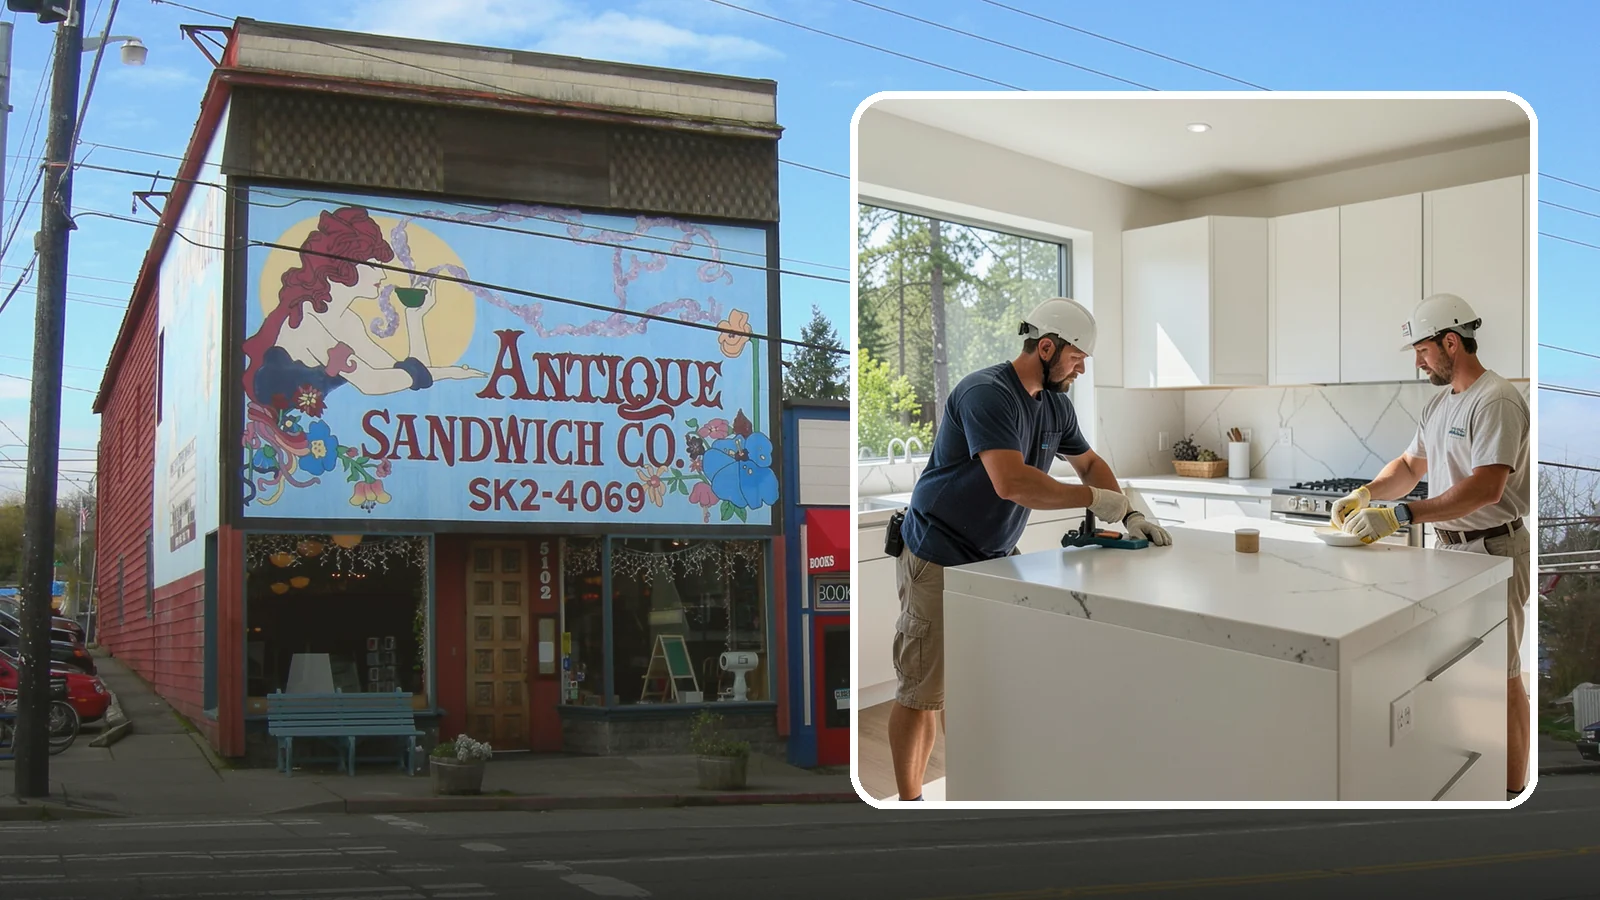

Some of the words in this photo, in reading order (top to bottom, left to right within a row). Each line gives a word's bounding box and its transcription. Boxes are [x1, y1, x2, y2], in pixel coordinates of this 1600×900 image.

[476, 329, 723, 420] ANTIQUE
[361, 408, 604, 468] SANDWICH
[617, 422, 684, 469] CO.
[468, 477, 645, 512] SK2-4069
[540, 542, 551, 599] 5102
[809, 555, 835, 569] BOOKS
